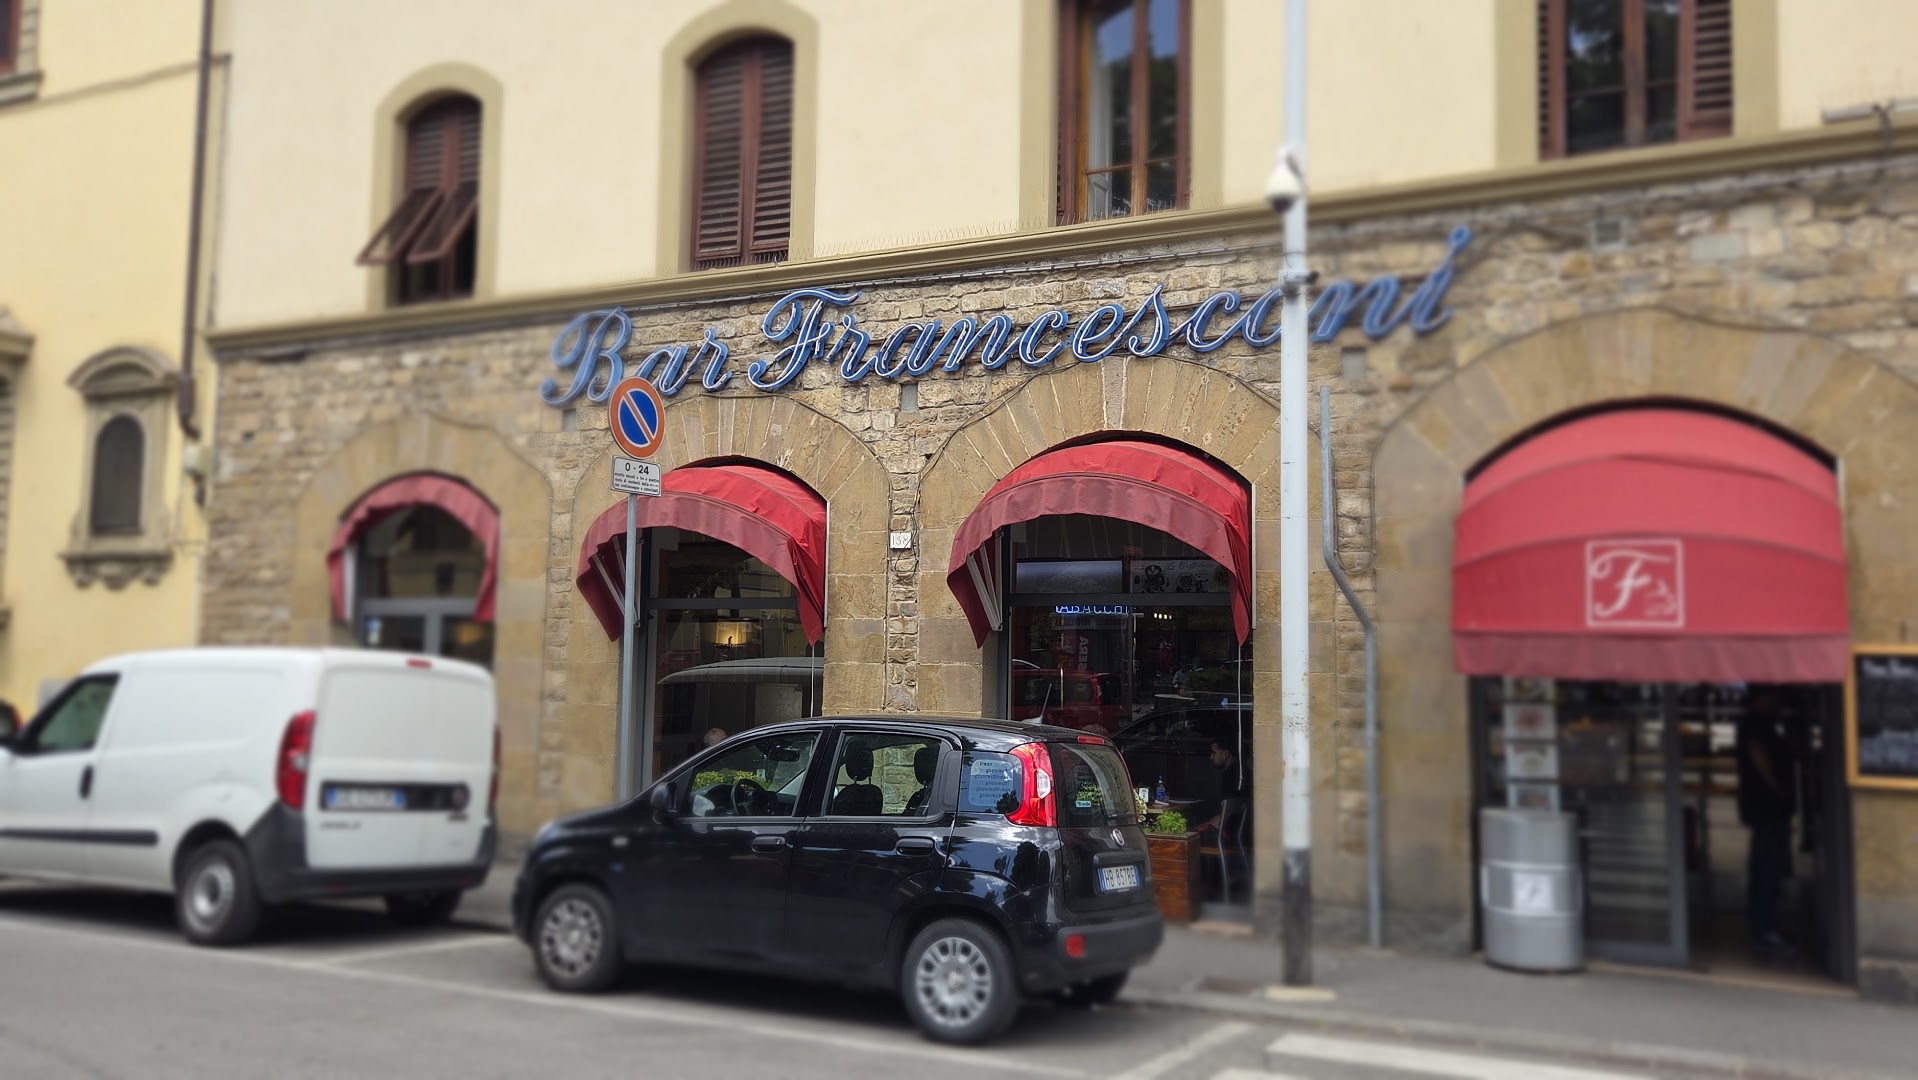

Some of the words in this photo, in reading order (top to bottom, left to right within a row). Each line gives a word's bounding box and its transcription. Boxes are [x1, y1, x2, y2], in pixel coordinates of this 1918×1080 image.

[540, 305, 733, 405] Bar
[748, 225, 1473, 392] Francesconi
[625, 462, 631, 471] 0
[638, 465, 649, 475] 24
[893, 535, 909, 546] 158
